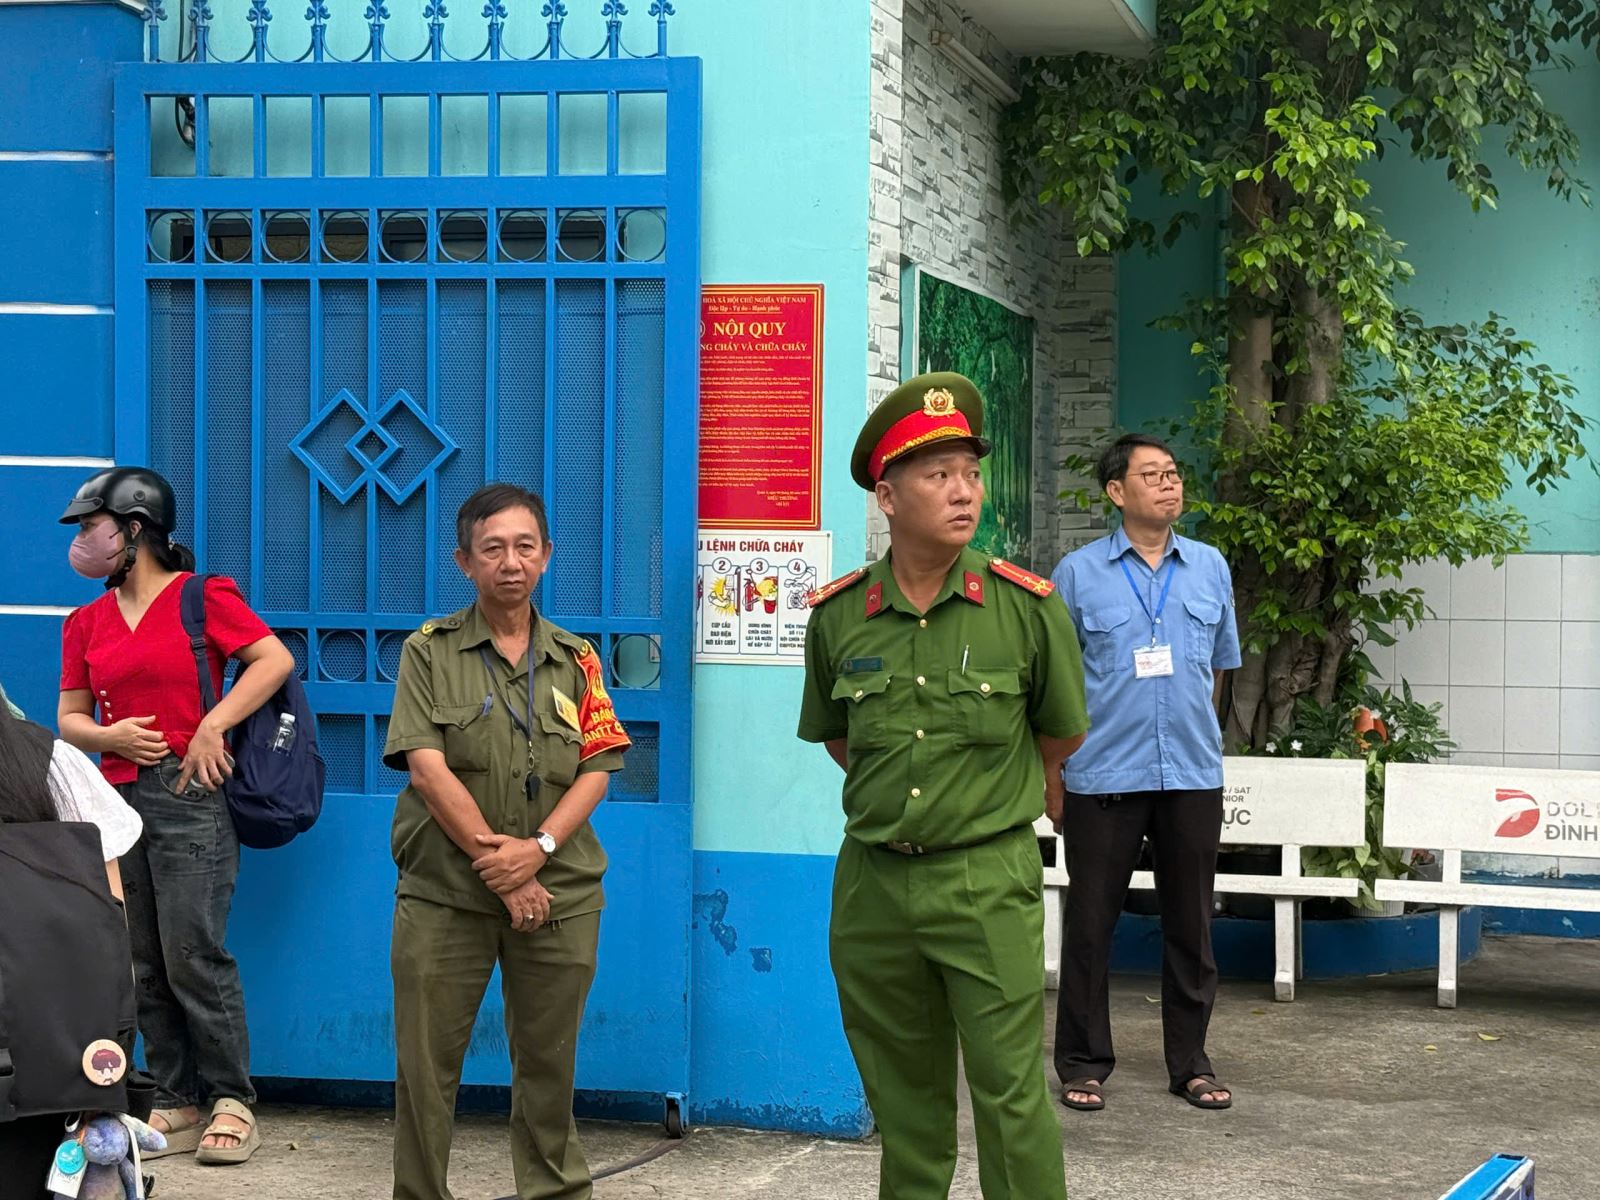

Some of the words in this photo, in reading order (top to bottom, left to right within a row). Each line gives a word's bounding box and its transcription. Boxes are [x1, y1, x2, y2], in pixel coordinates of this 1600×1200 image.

[713, 318, 745, 340] NỘI
[749, 322, 786, 339] QUY
[700, 343, 713, 351] NG
[714, 342, 739, 351] CHÁY
[741, 342, 753, 351] VÀ
[755, 342, 779, 351] CHỮA
[781, 342, 808, 351] CHÁY
[706, 538, 736, 553] LỆNH
[740, 538, 770, 552] CHỮA
[774, 539, 804, 553] CHÁY
[719, 560, 726, 571] 2
[756, 561, 763, 572] 3
[793, 562, 801, 572] 4
[584, 724, 612, 744] ANTT
[1234, 786, 1251, 794] SAT
[1222, 807, 1251, 829] ỰC
[1544, 819, 1598, 841] ĐÌNH
